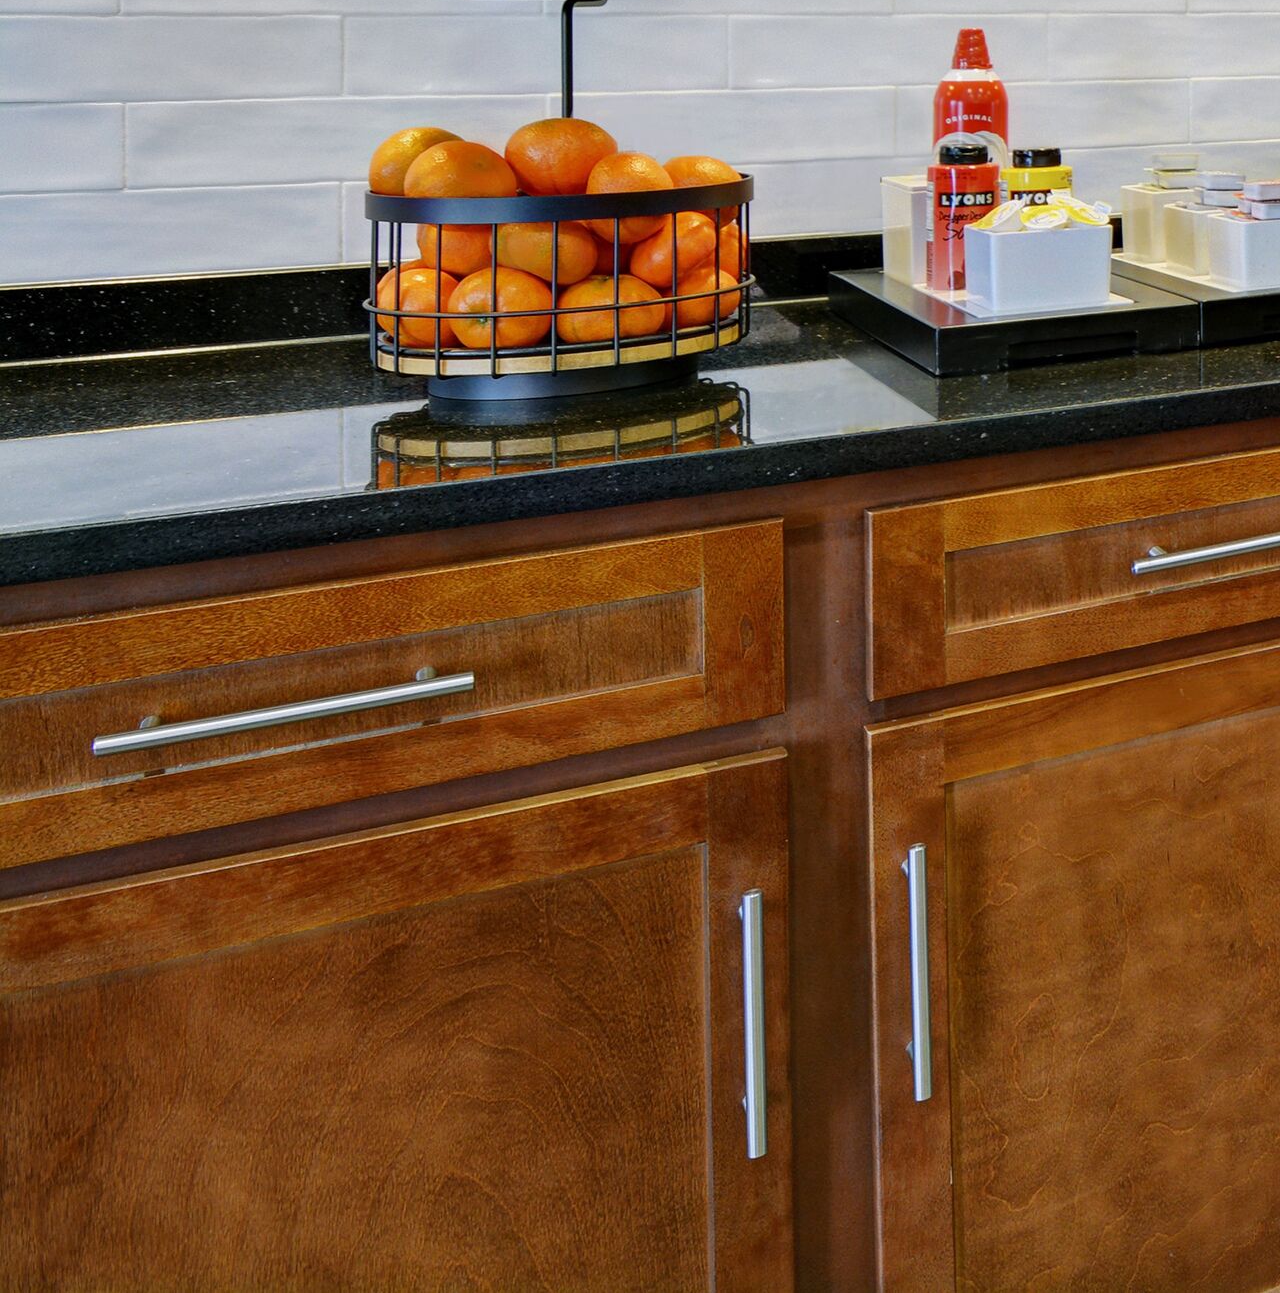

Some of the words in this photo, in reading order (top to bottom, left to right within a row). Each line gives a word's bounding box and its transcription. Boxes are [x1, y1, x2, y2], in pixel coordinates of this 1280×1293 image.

[946, 114, 992, 124] ORIGINAL
[941, 193, 993, 206] LYONS
[1013, 192, 1052, 206] LYO
